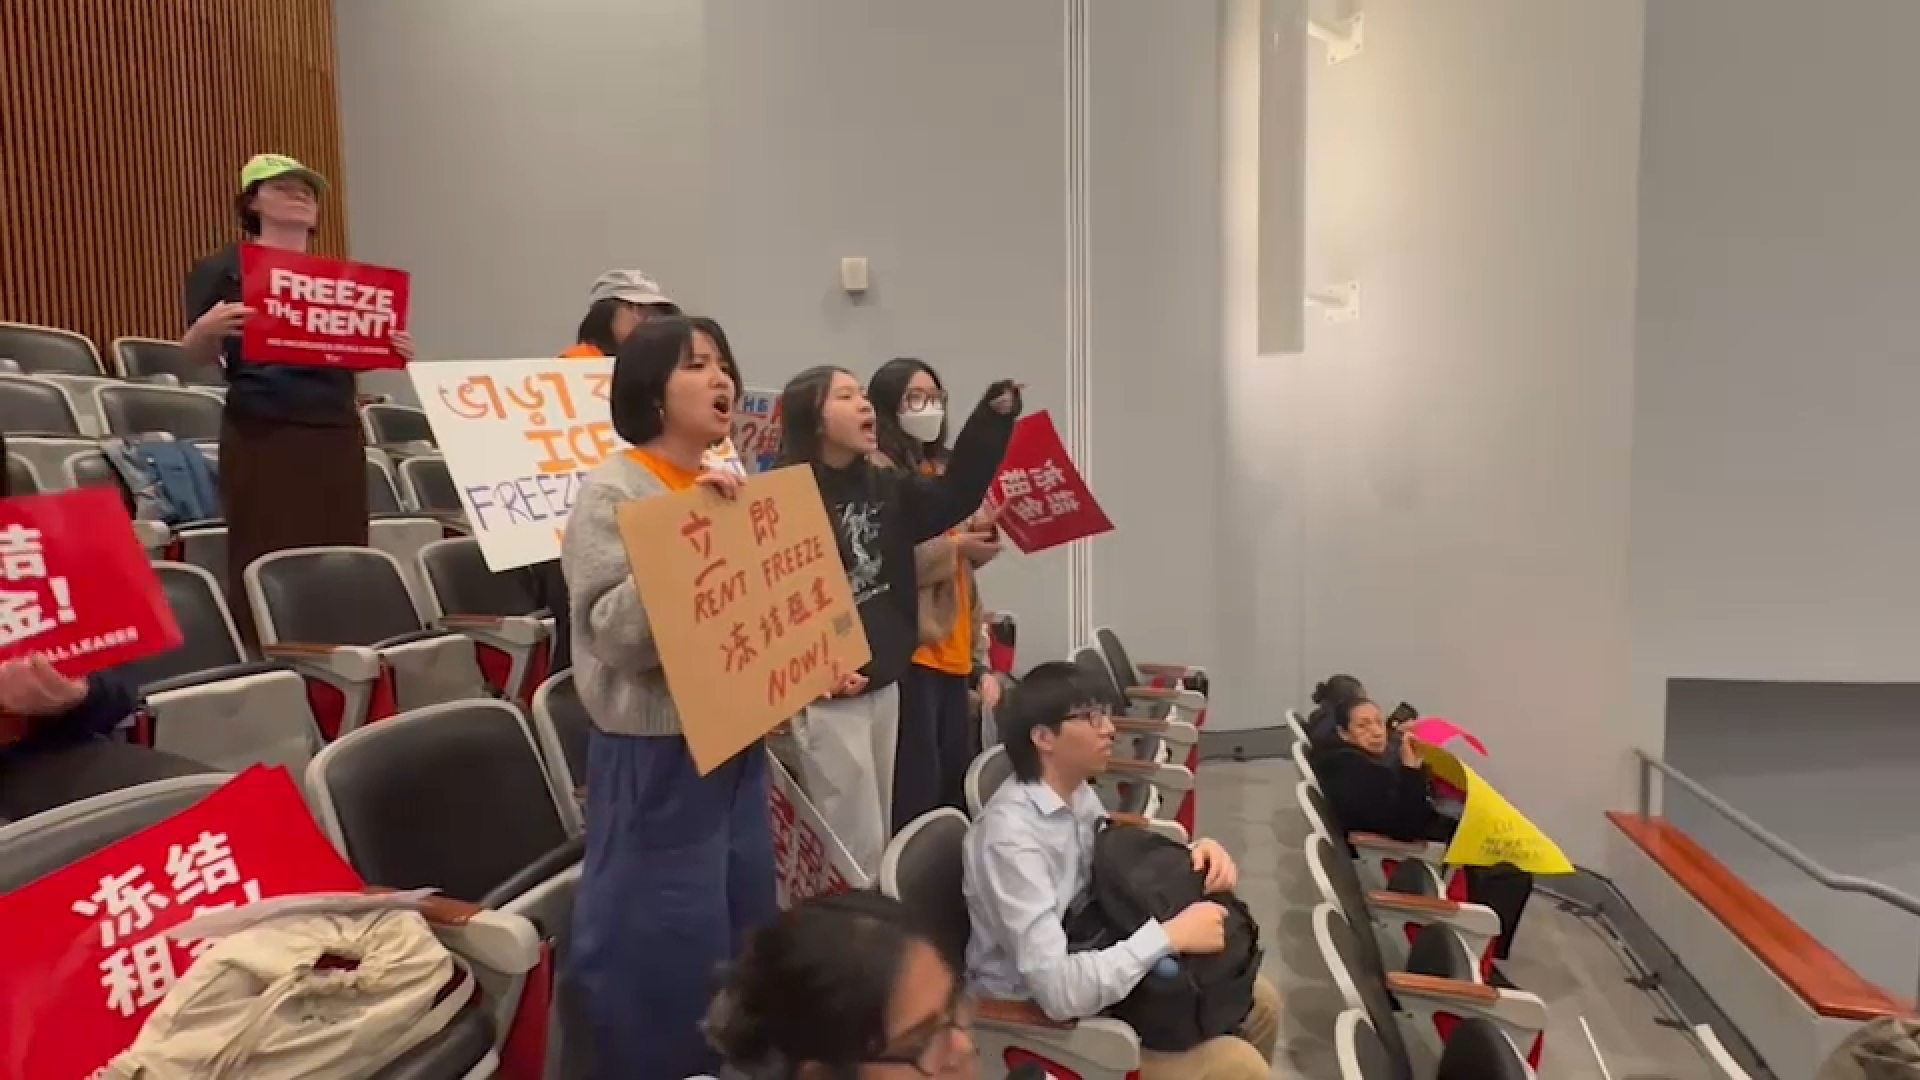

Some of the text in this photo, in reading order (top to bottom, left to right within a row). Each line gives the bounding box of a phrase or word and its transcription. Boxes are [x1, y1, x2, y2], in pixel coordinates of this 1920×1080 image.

[263, 297, 303, 326] THE
[270, 267, 395, 313] FREEZE
[743, 395, 769, 413] HE
[524, 420, 615, 473] ICE
[465, 472, 587, 532] FREEZ
[693, 535, 824, 624] RENT FREEZE
[767, 631, 829, 706] NOW!
[71, 830, 241, 948] 冻结
